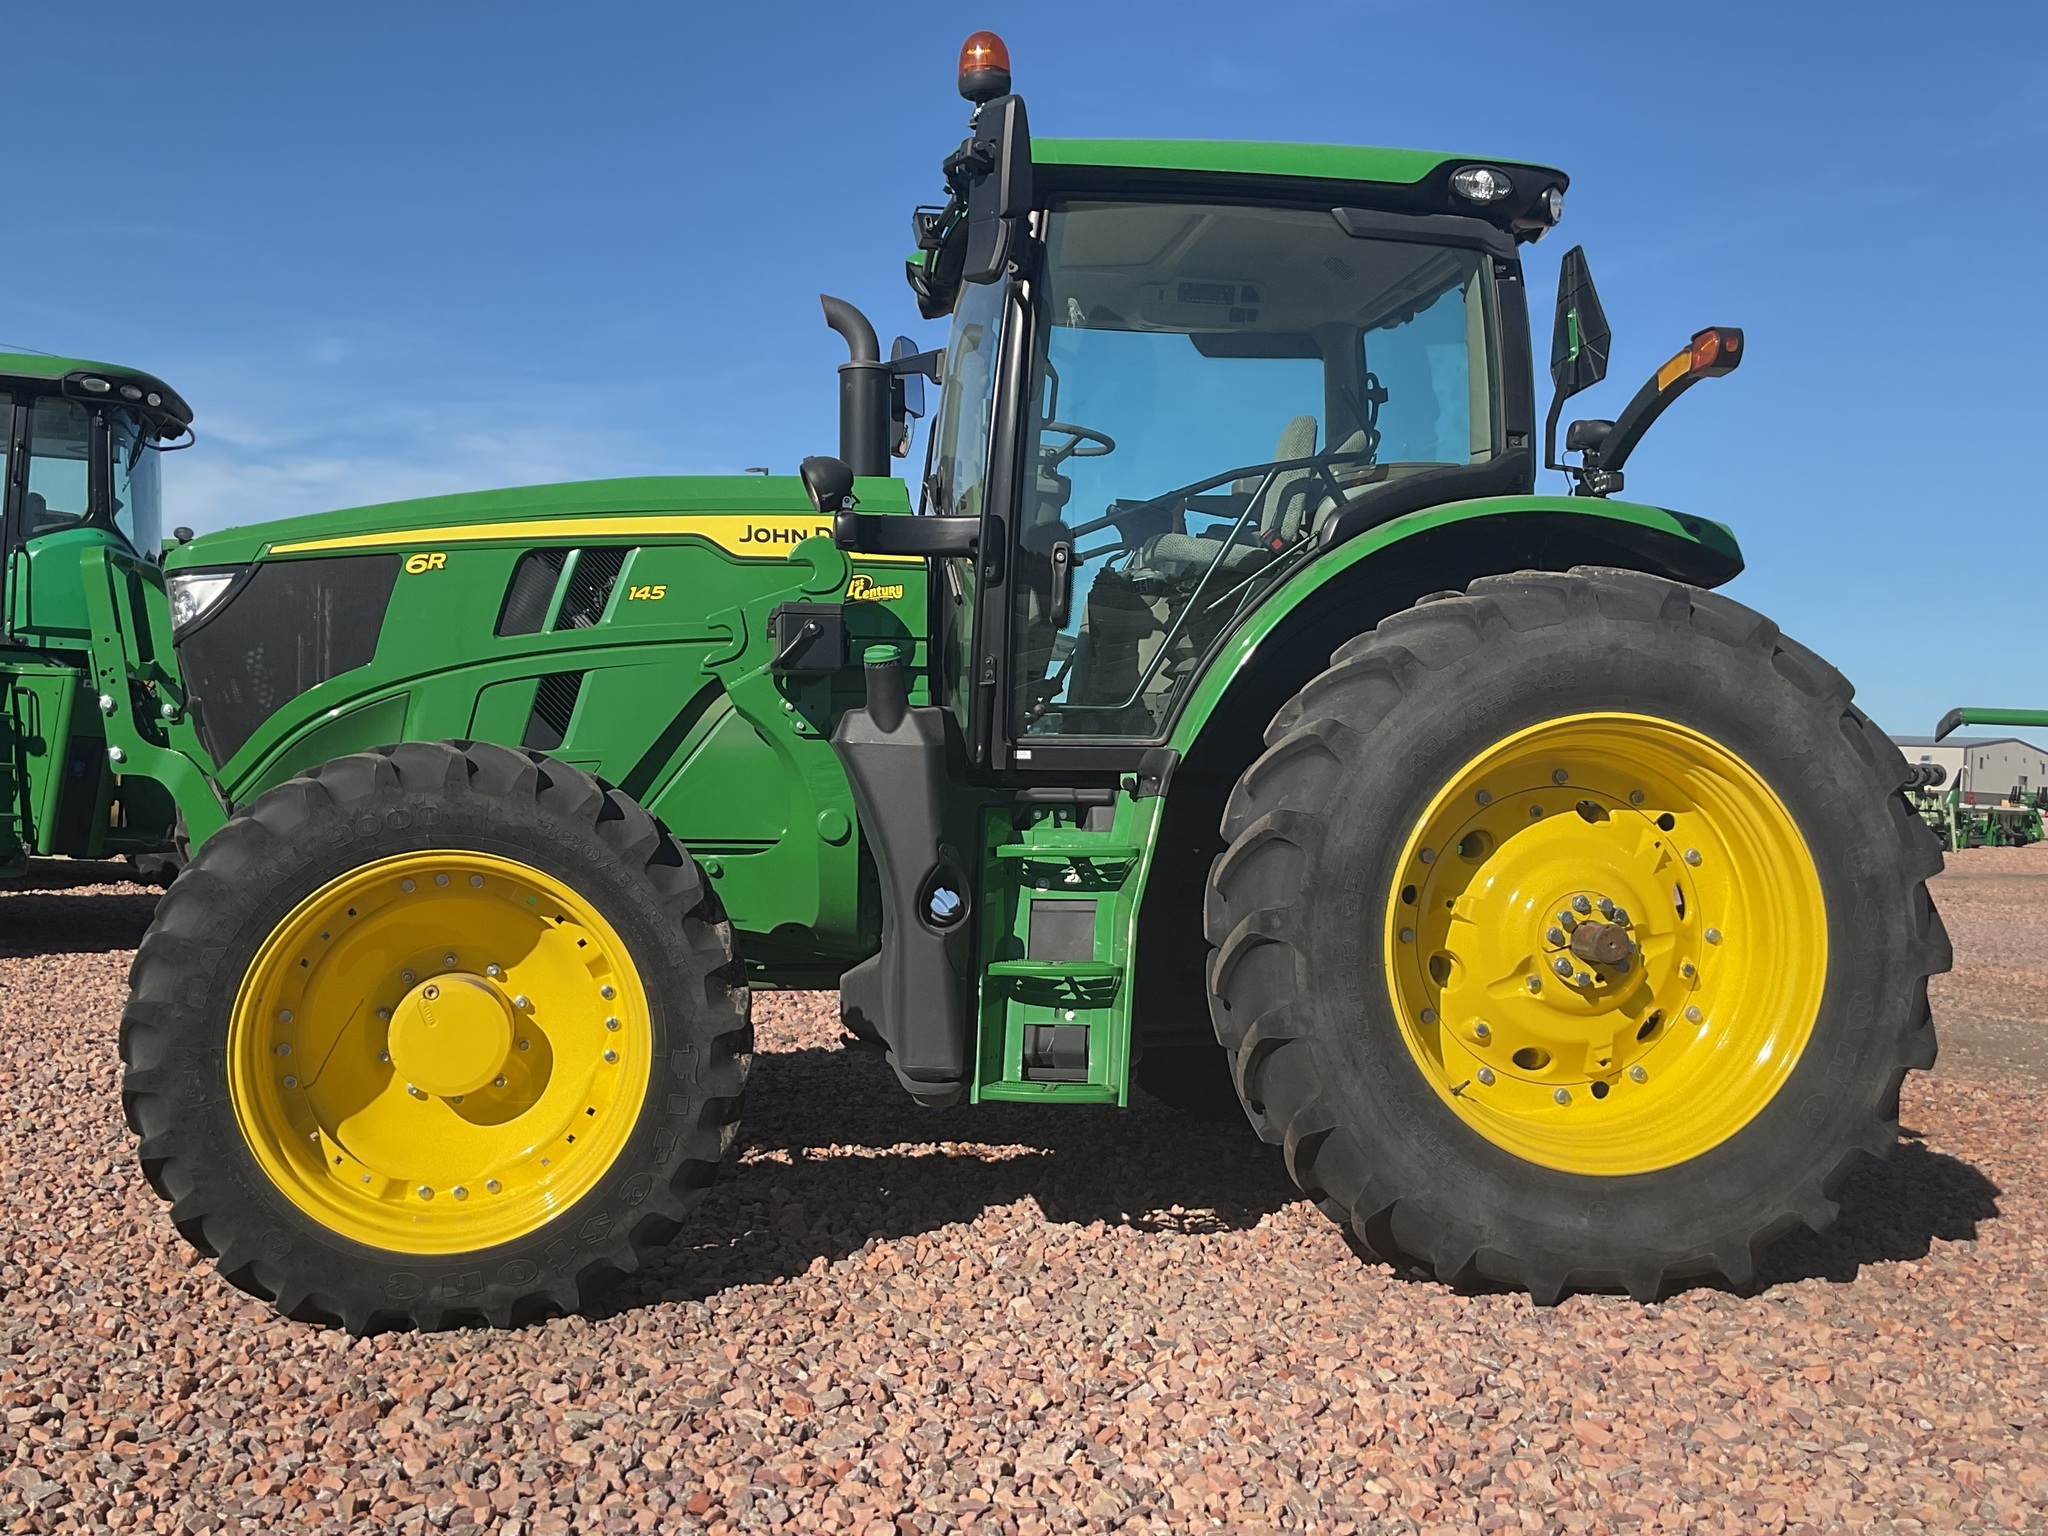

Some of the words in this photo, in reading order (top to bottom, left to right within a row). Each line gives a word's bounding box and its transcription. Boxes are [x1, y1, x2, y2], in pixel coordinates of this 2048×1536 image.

[738, 524, 808, 544] JOHN
[405, 553, 447, 574] 6R
[628, 585, 667, 601] 145
